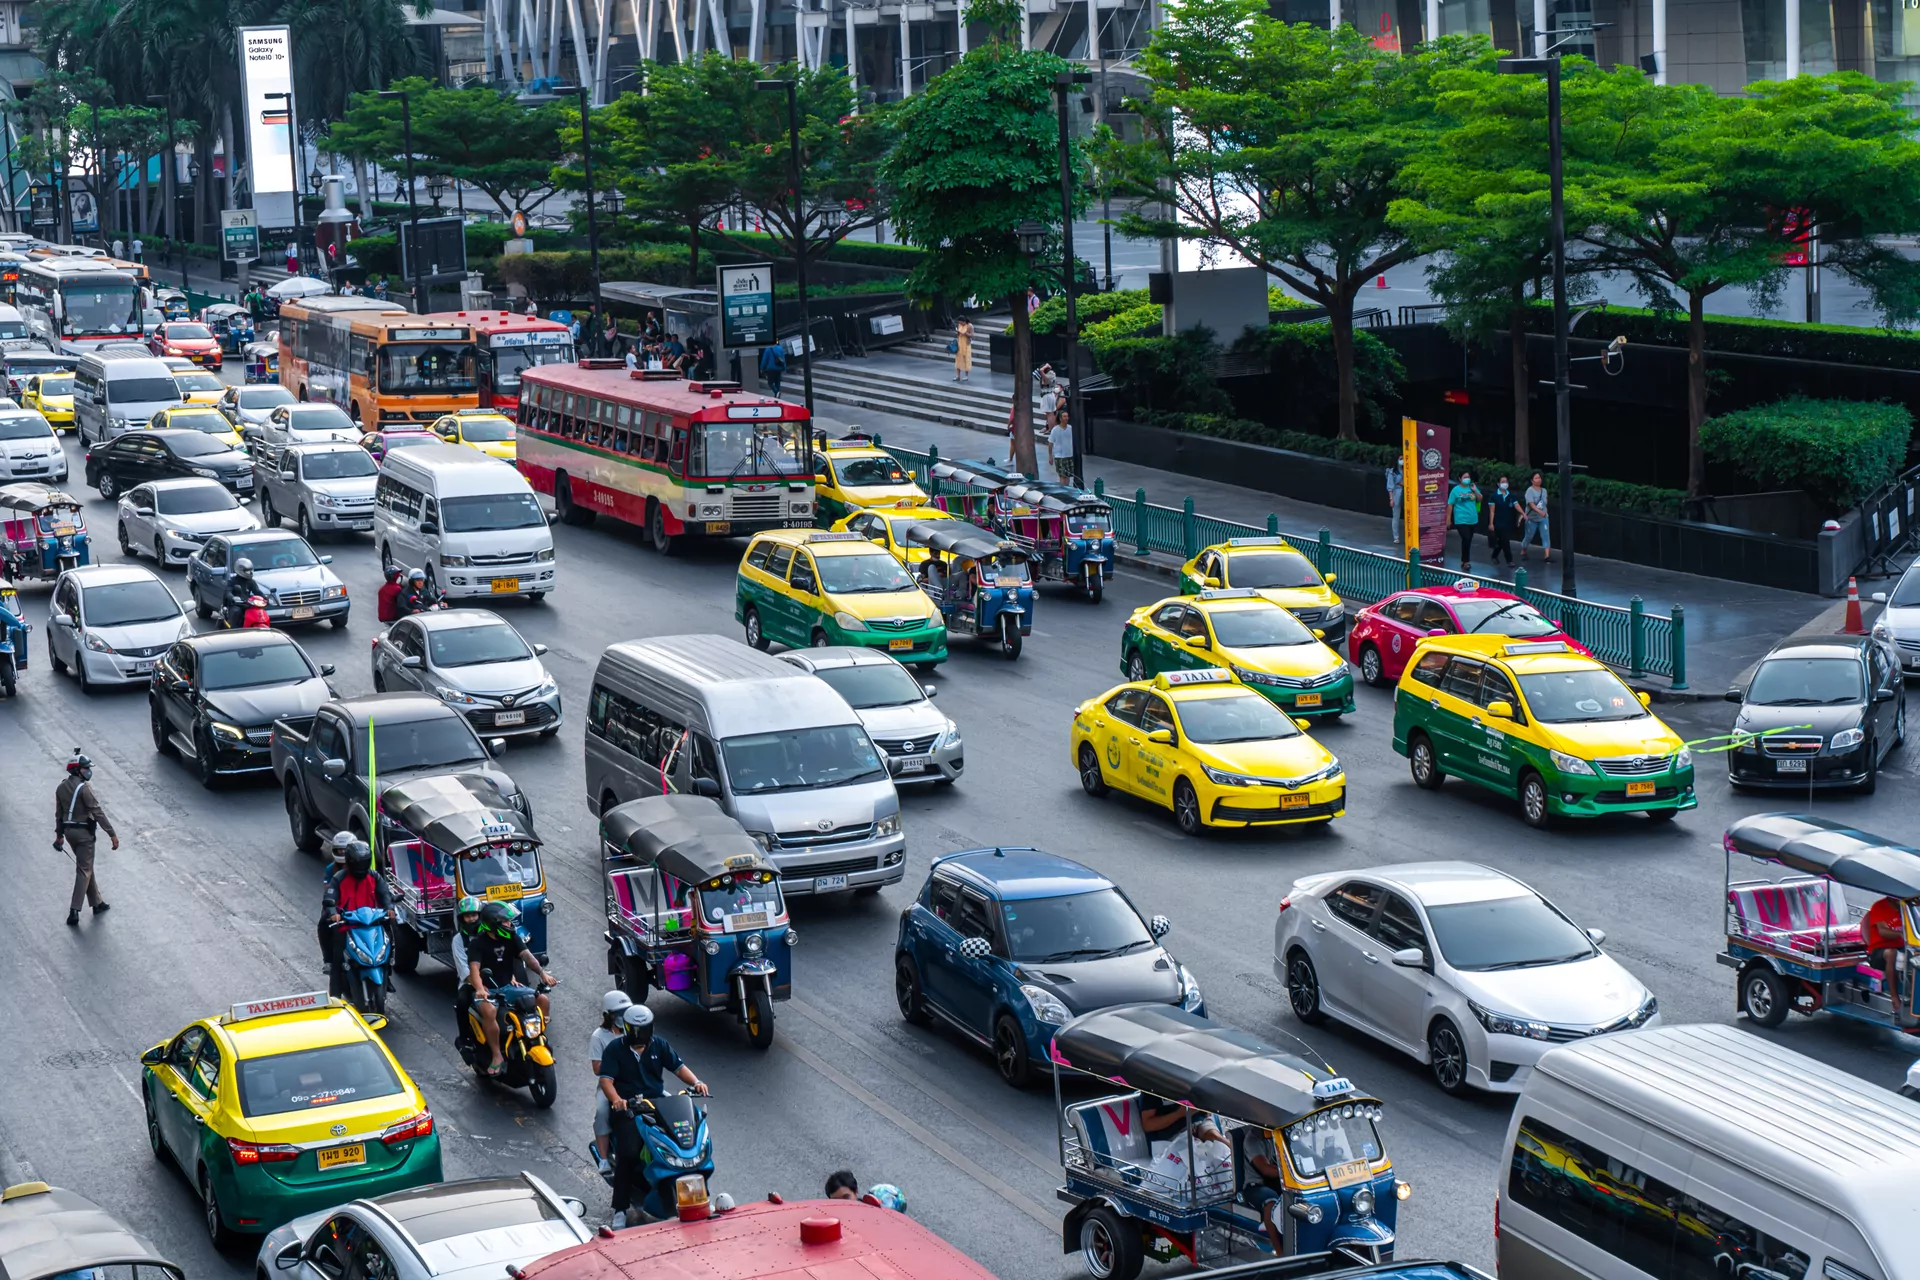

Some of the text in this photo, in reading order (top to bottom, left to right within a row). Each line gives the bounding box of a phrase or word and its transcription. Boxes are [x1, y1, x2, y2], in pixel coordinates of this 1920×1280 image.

[527, 332, 538, 342] 14
[752, 408, 759, 417] 2
[493, 582, 516, 590] 34-1841
[1183, 671, 1214, 682] TAXI
[909, 759, 923, 767] 6312
[488, 825, 508, 833] TAXI
[733, 856, 753, 865] TAXI
[831, 876, 845, 885] 724
[503, 885, 520, 893] 3386
[246, 996, 317, 1015] TAXI-METER
[1325, 1079, 1350, 1093] TAXI
[318, 1087, 356, 1099] 3713849
[343, 1147, 360, 1158] 920
[1348, 1161, 1367, 1175] 5772
